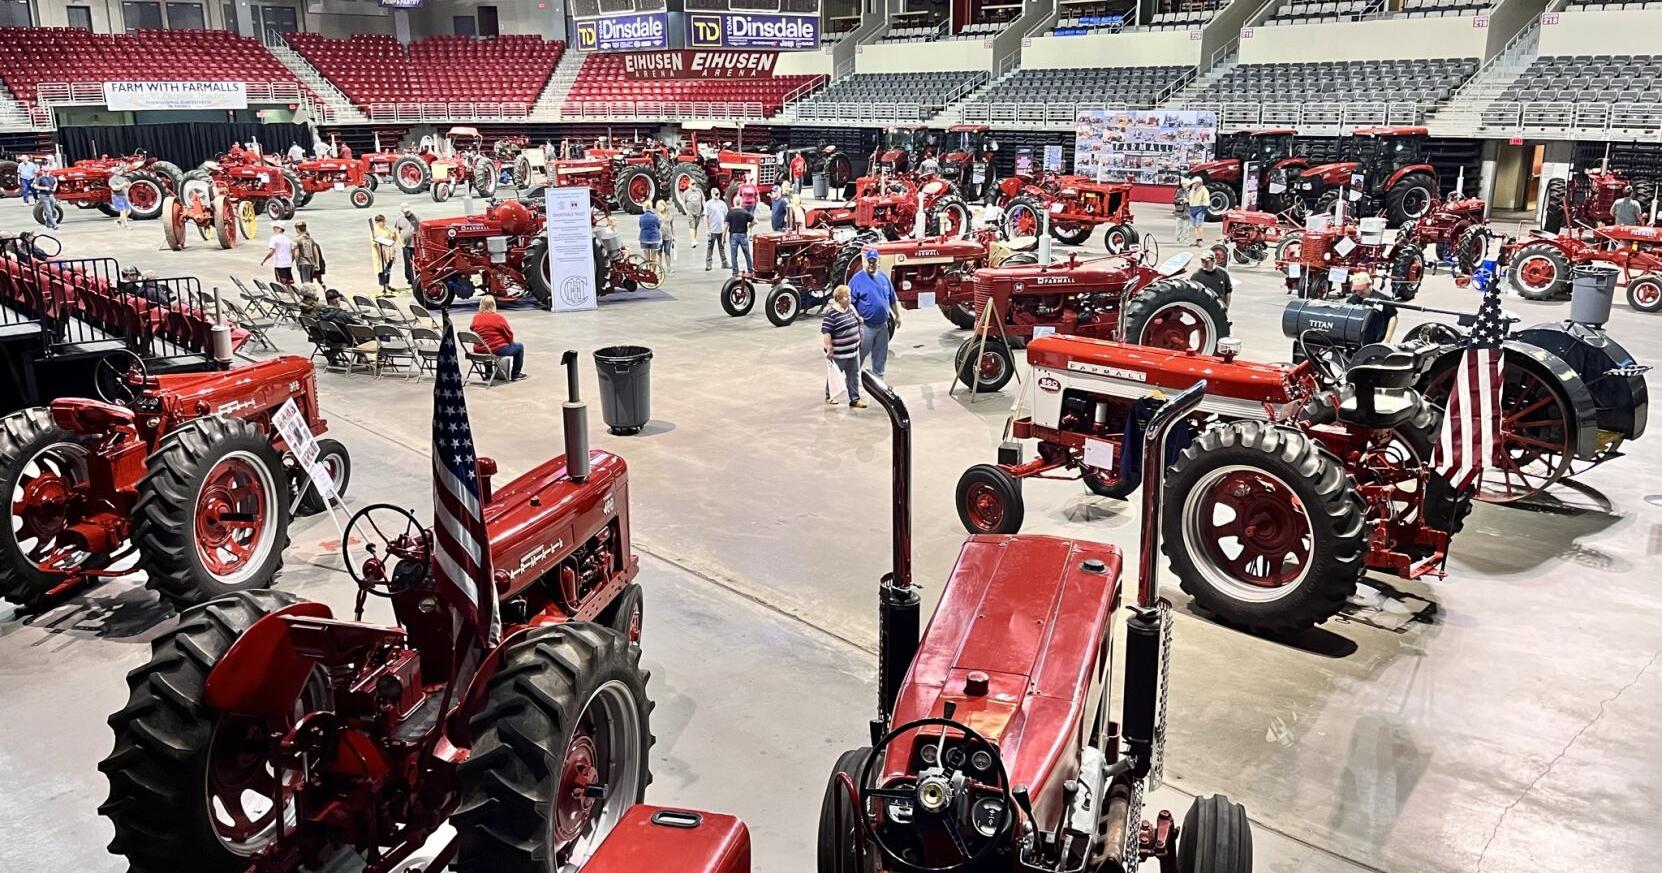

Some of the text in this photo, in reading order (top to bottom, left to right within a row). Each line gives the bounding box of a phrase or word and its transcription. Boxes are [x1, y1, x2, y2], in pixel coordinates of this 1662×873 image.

[603, 16, 662, 39] Dinsdale
[693, 22, 720, 40] TD
[732, 16, 814, 38] Dinsdale
[580, 28, 595, 45] TD
[625, 53, 683, 73] EIHUSEN
[691, 53, 774, 71] EIHUSEN
[635, 69, 675, 78] ARENA
[701, 69, 757, 77] ARENA
[111, 82, 239, 93] FARM WITH FARMALLS
[1309, 320, 1334, 329] TITAN
[1070, 364, 1144, 380] FARMALL
[510, 538, 563, 579] ARMALL
